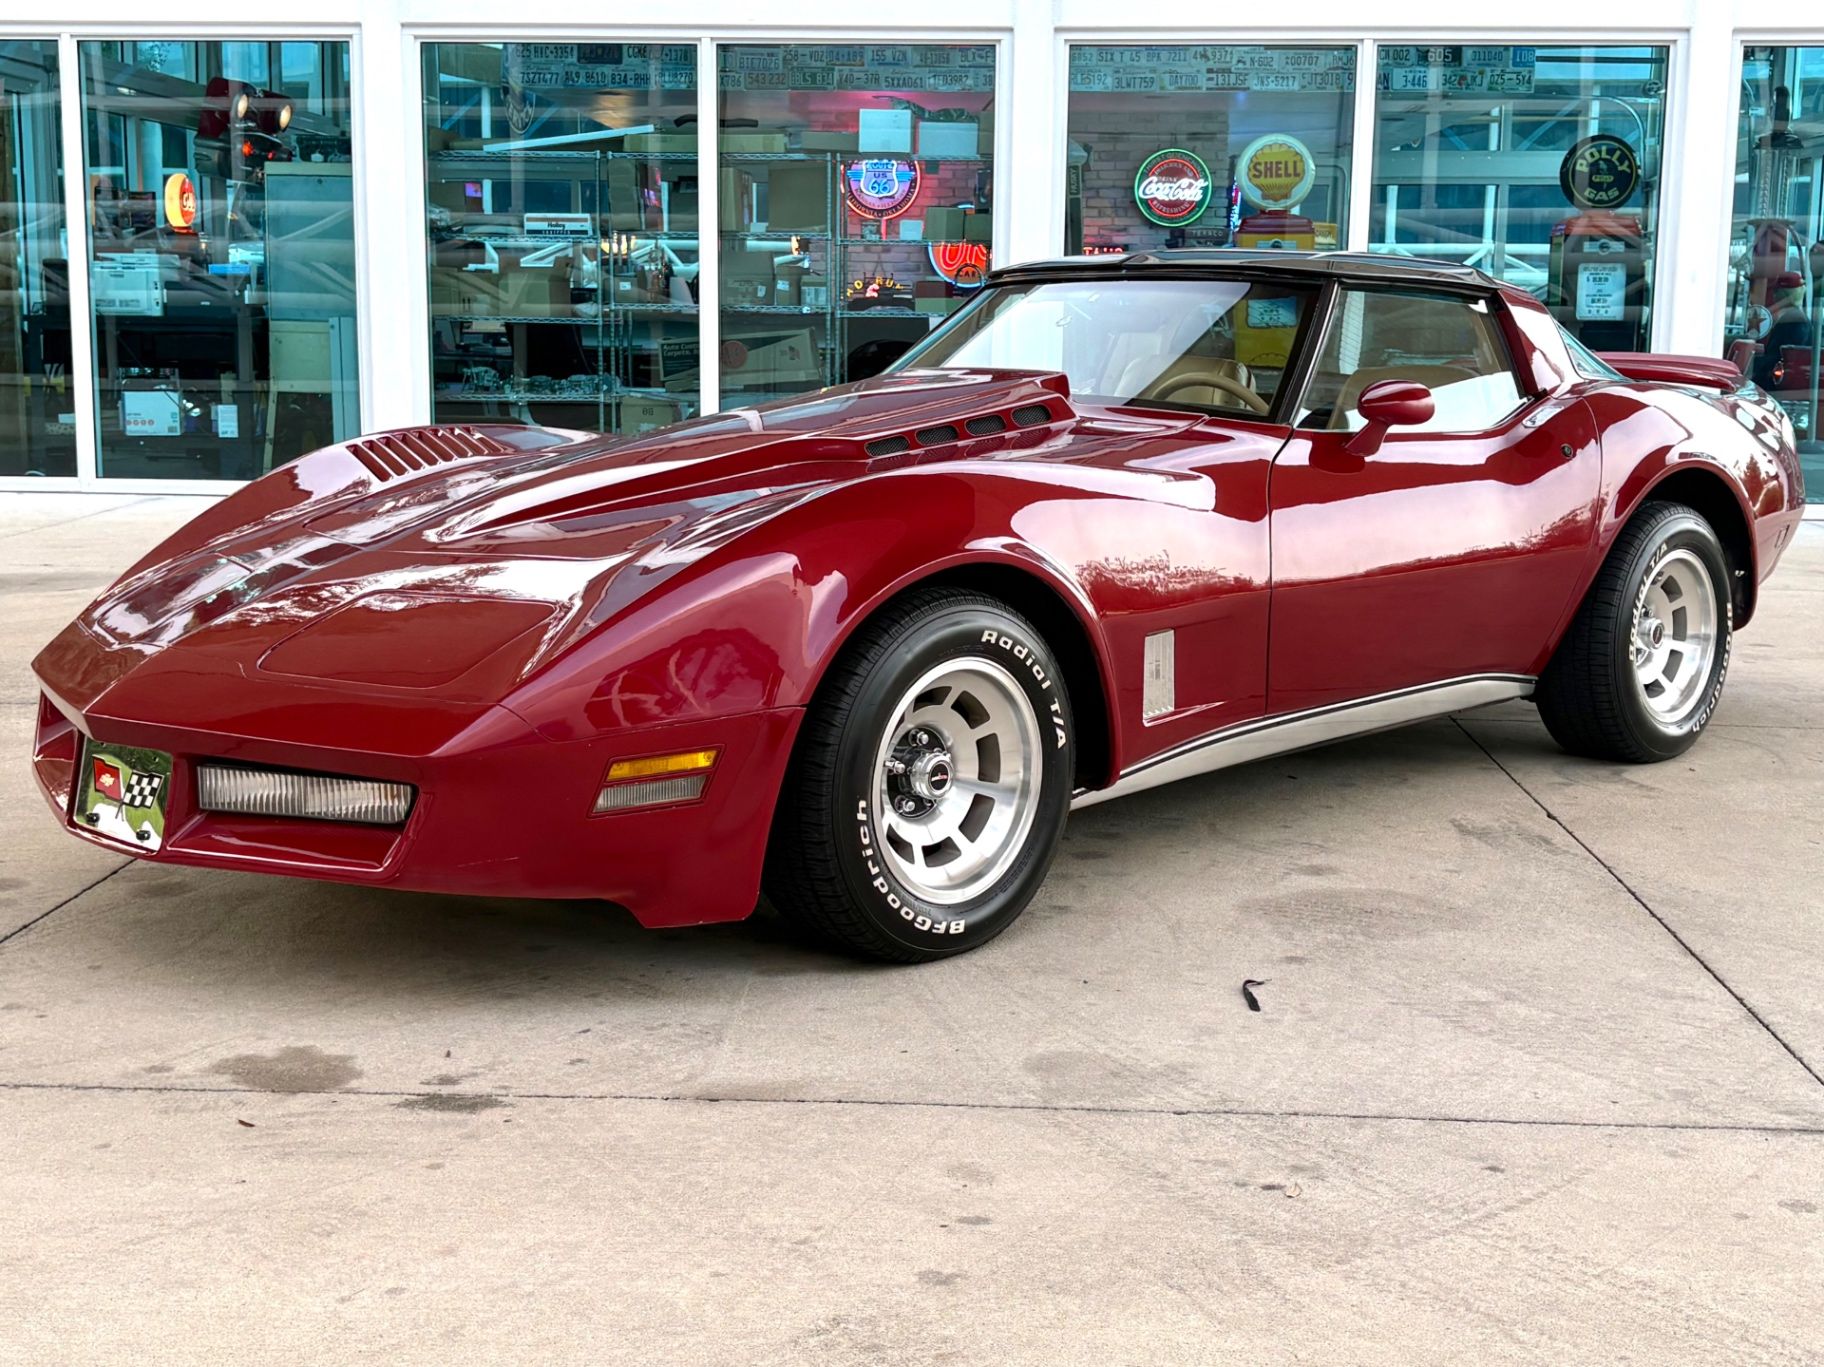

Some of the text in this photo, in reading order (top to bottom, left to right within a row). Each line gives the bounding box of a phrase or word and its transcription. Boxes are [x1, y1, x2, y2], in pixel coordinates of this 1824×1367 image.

[1428, 48, 1453, 62] 605
[1252, 161, 1301, 179] SHELL
[1575, 145, 1631, 173] POLLY
[869, 179, 890, 195] 66
[1583, 187, 1620, 201] GAS
[981, 629, 1051, 690] Radial
[1050, 697, 1067, 750] T/A
[856, 799, 966, 935] BFGoodrich
